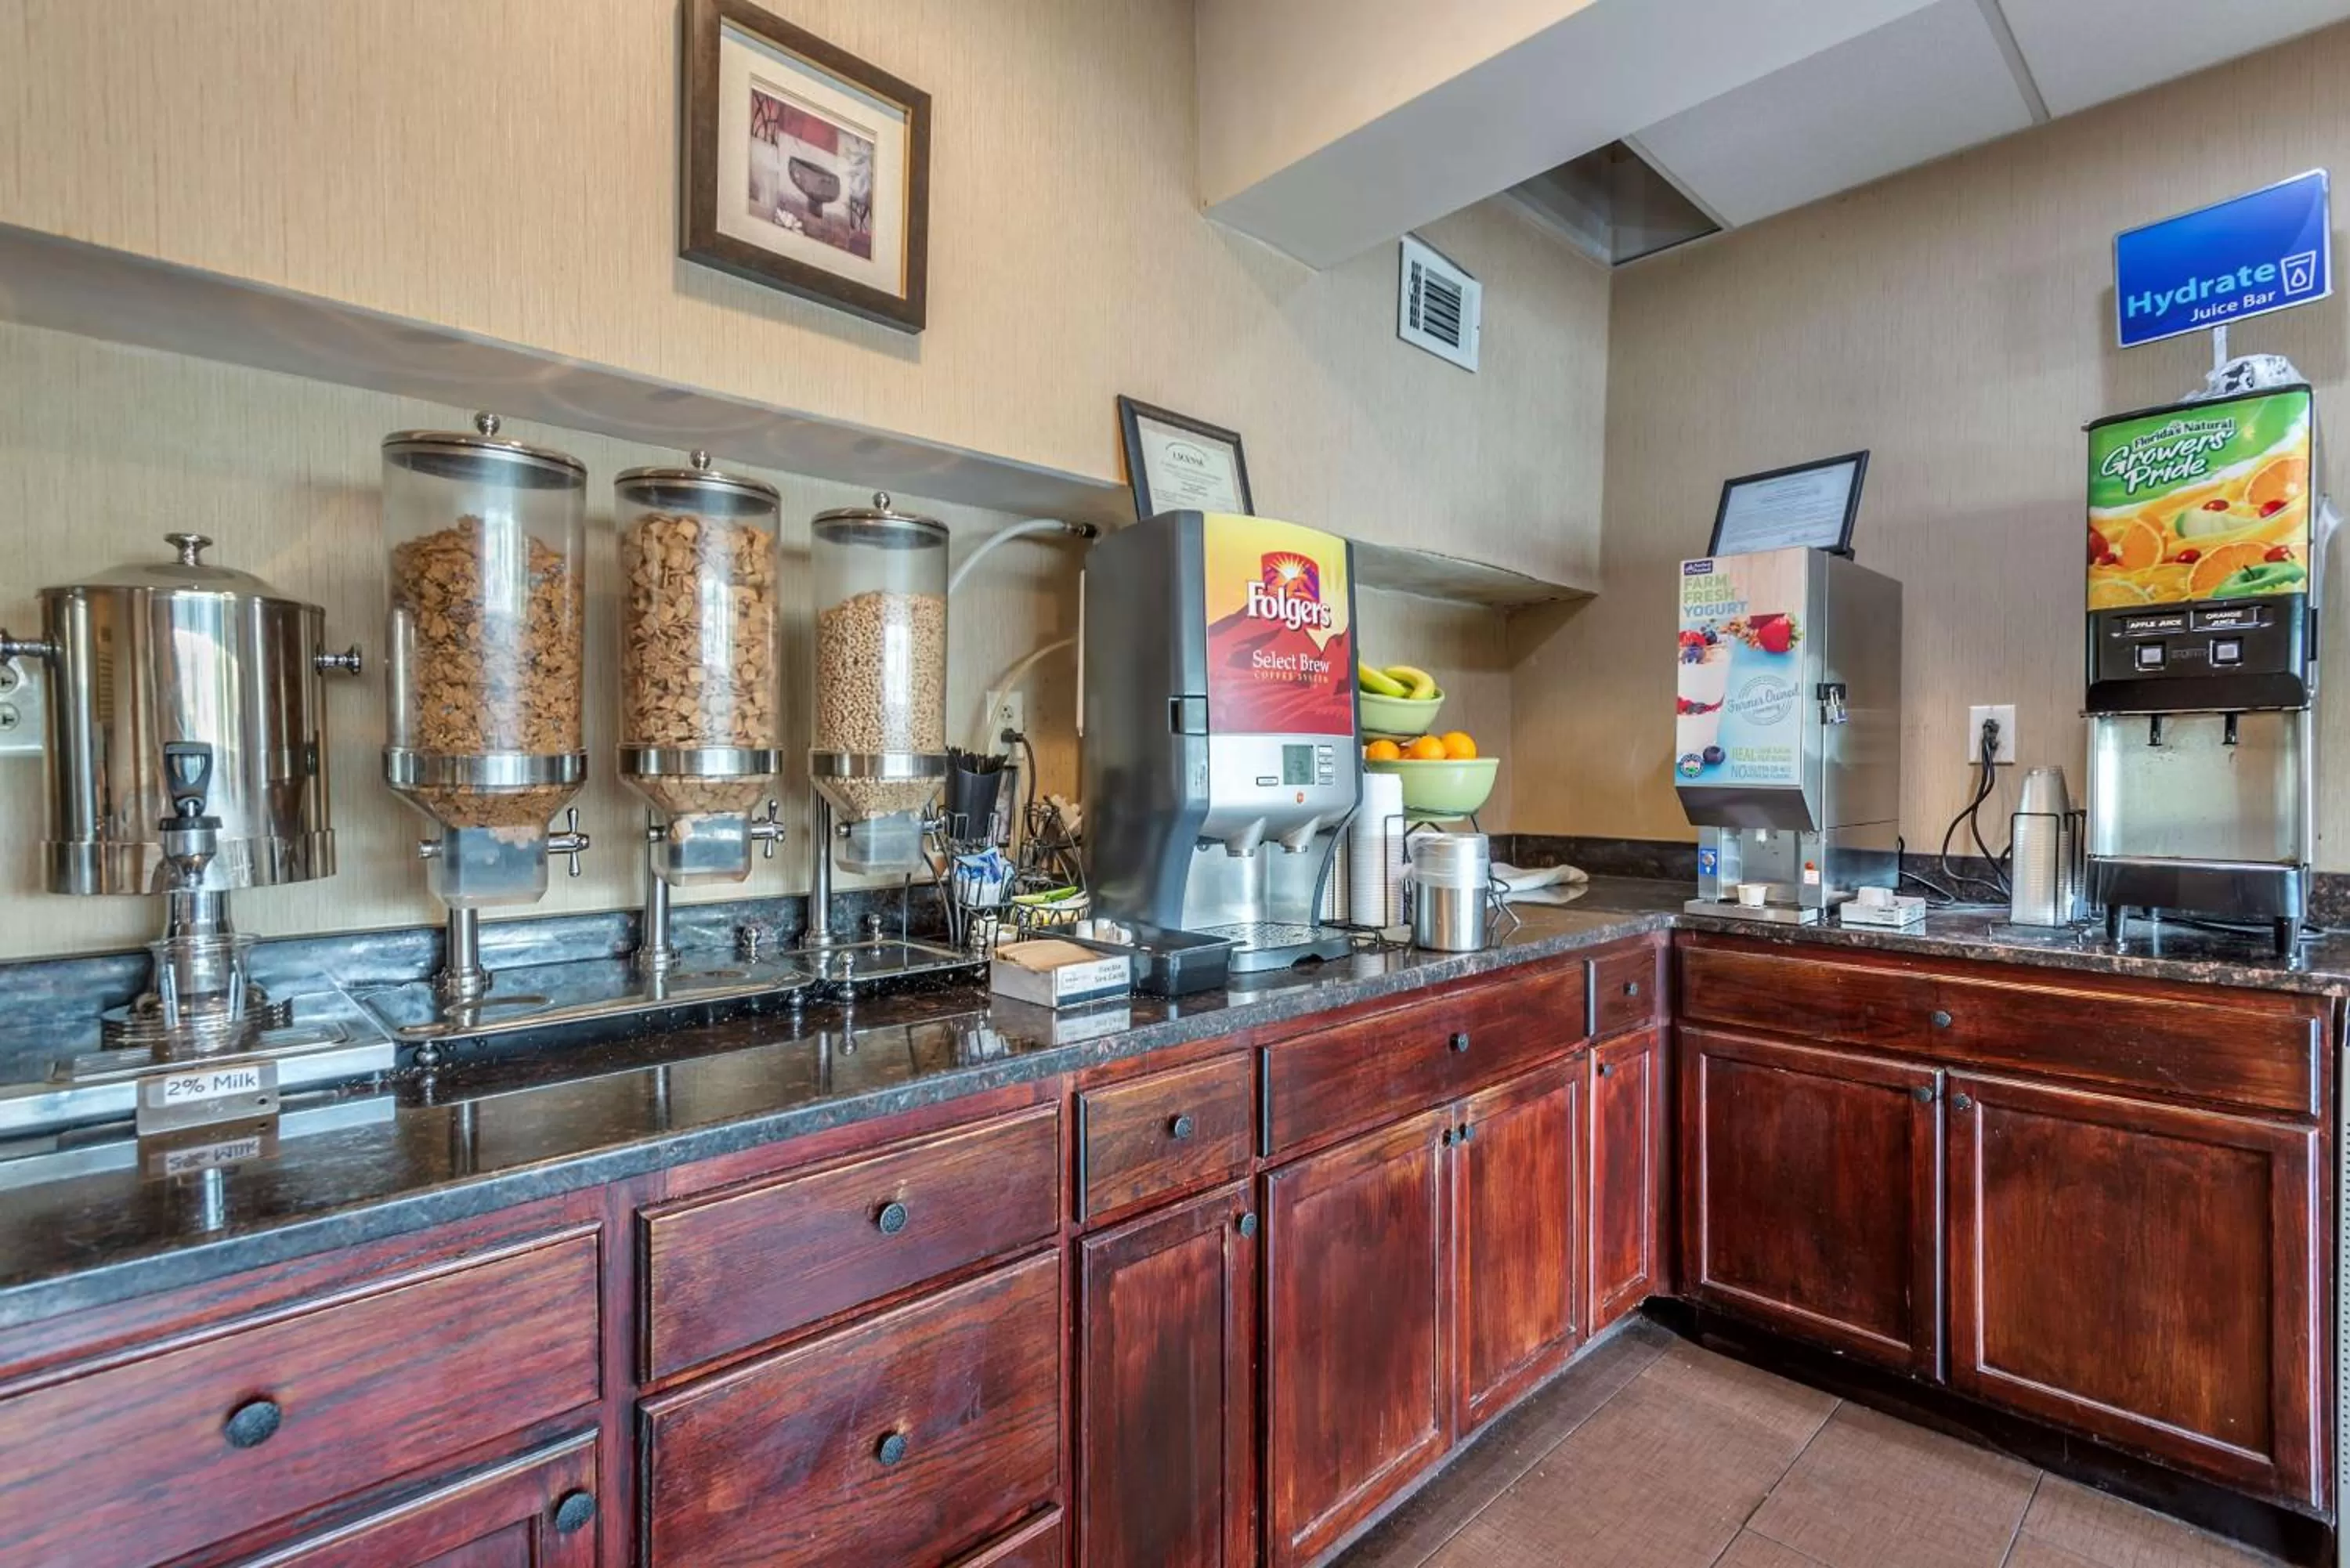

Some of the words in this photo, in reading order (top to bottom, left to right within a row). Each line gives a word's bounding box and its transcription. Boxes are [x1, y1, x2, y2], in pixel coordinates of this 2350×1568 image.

[2127, 263, 2276, 318] Hydrate
[2190, 302, 2238, 322] Juice
[2243, 290, 2276, 309] Bar
[2184, 418, 2232, 432] Natural
[2124, 453, 2206, 493] Pride
[1684, 574, 1727, 590] FARM
[1247, 581, 1332, 630] Folgers
[1684, 588, 1735, 603] FRESH
[1684, 602, 1747, 617] YOGURT
[1253, 649, 1296, 669] Select
[1300, 653, 1329, 673] Brew
[1254, 671, 1292, 681] COFFEE
[167, 1077, 205, 1096] 2%
[213, 1072, 257, 1091] Milk
